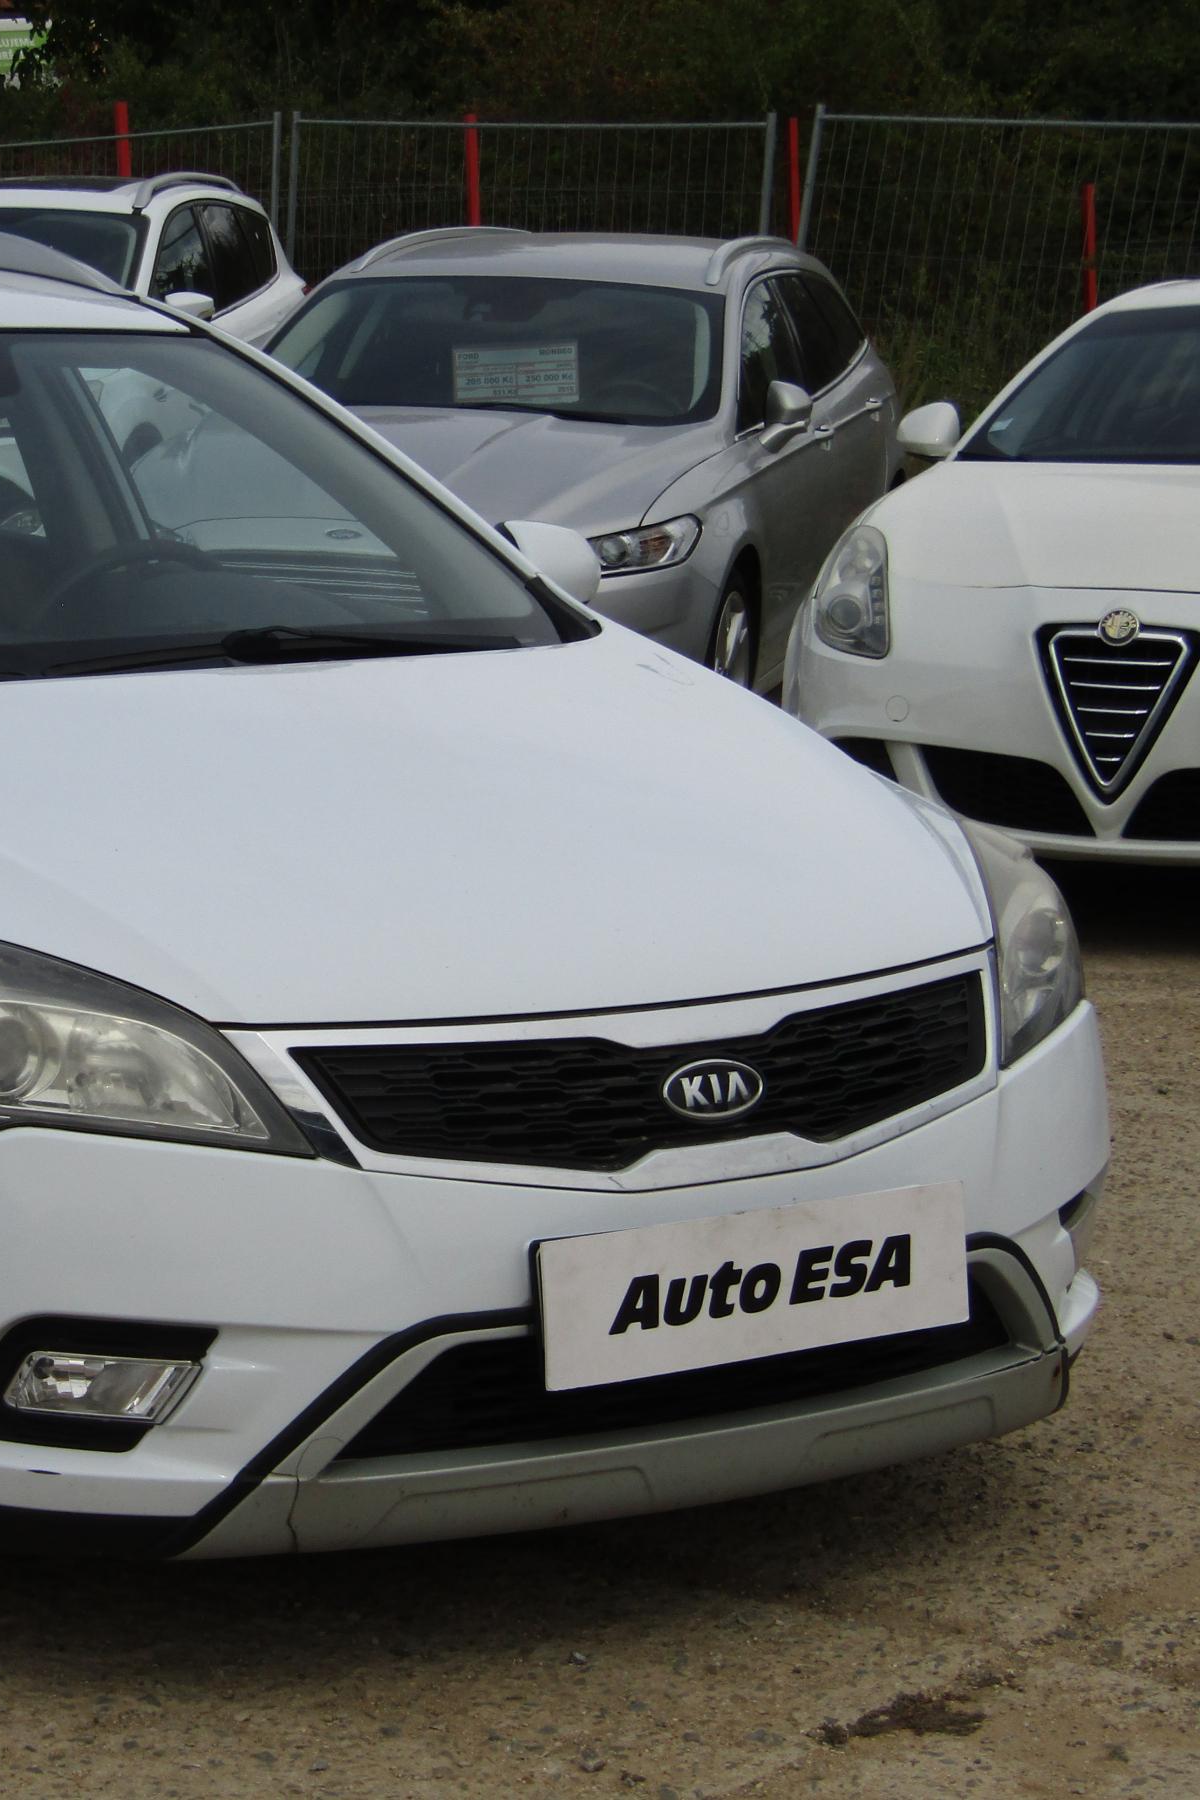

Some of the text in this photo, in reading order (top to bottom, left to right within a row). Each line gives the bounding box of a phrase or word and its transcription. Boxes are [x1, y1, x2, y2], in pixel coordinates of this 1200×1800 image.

[457, 347, 573, 360] FORD MONDEO
[679, 1070, 749, 1108] KIA
[608, 1233, 911, 1335] Auto ESA
